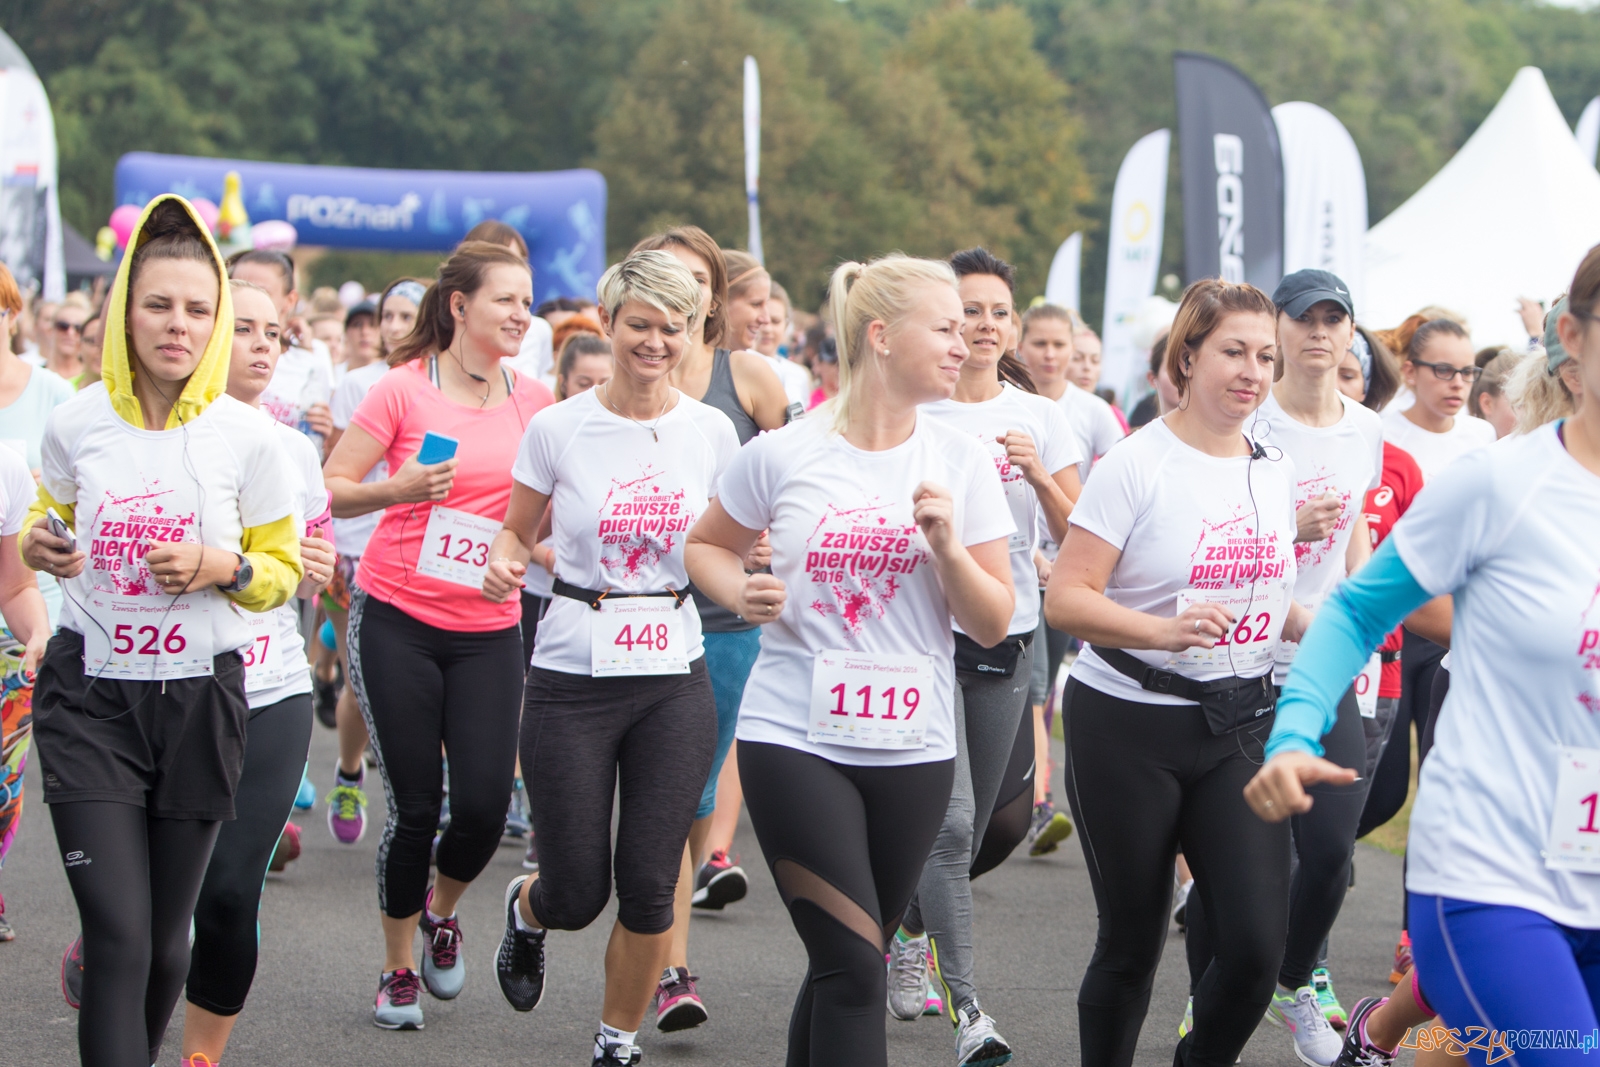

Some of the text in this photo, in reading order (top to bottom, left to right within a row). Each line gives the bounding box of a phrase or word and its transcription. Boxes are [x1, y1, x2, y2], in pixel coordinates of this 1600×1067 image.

[611, 502, 680, 516] zawsze
[128, 515, 176, 526] BIEG KOBIET
[100, 521, 185, 543] zawsze
[851, 525, 900, 536] BIEG KOBIET
[602, 534, 631, 544] 2016
[820, 532, 910, 554] zawsze
[1243, 537, 1266, 545] KOBIET
[436, 533, 489, 567] 123
[1205, 545, 1276, 561] zawsze
[93, 557, 122, 571] 2016
[811, 570, 844, 583] 2016
[1254, 594, 1269, 602] 2016
[111, 604, 138, 613] Zawsze
[171, 602, 190, 611] 2016
[113, 623, 187, 655] 526
[614, 623, 668, 651] 448
[844, 661, 871, 671] Zawsze
[829, 682, 920, 721] 1119
